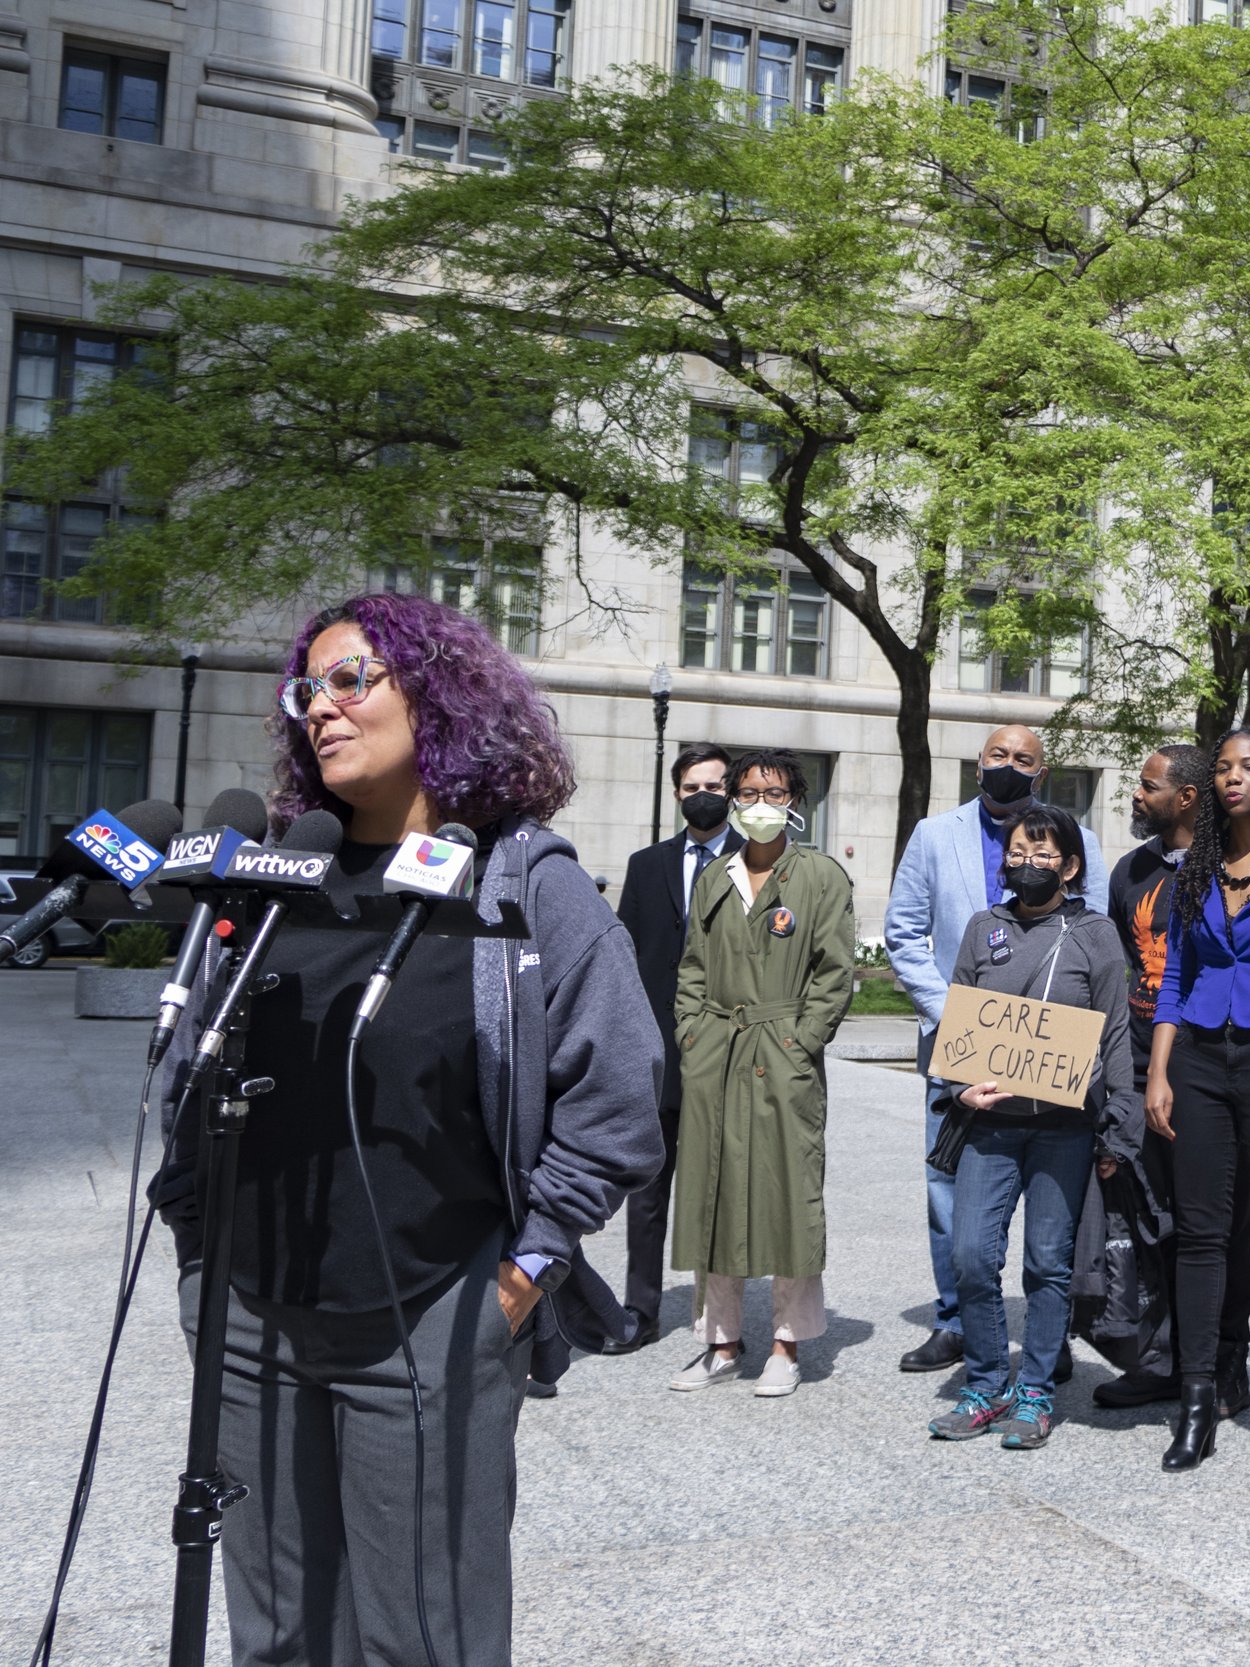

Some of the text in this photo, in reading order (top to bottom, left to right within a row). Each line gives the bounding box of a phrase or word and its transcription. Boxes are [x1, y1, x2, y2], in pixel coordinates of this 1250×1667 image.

[76, 833, 159, 881] NEWS 5
[170, 833, 221, 860] WGN
[235, 853, 302, 876] wttw
[397, 864, 447, 882] NOTICIAS
[978, 999, 1052, 1040] CARE
[943, 1028, 975, 1061] not
[988, 1044, 1091, 1095] CURFEW
